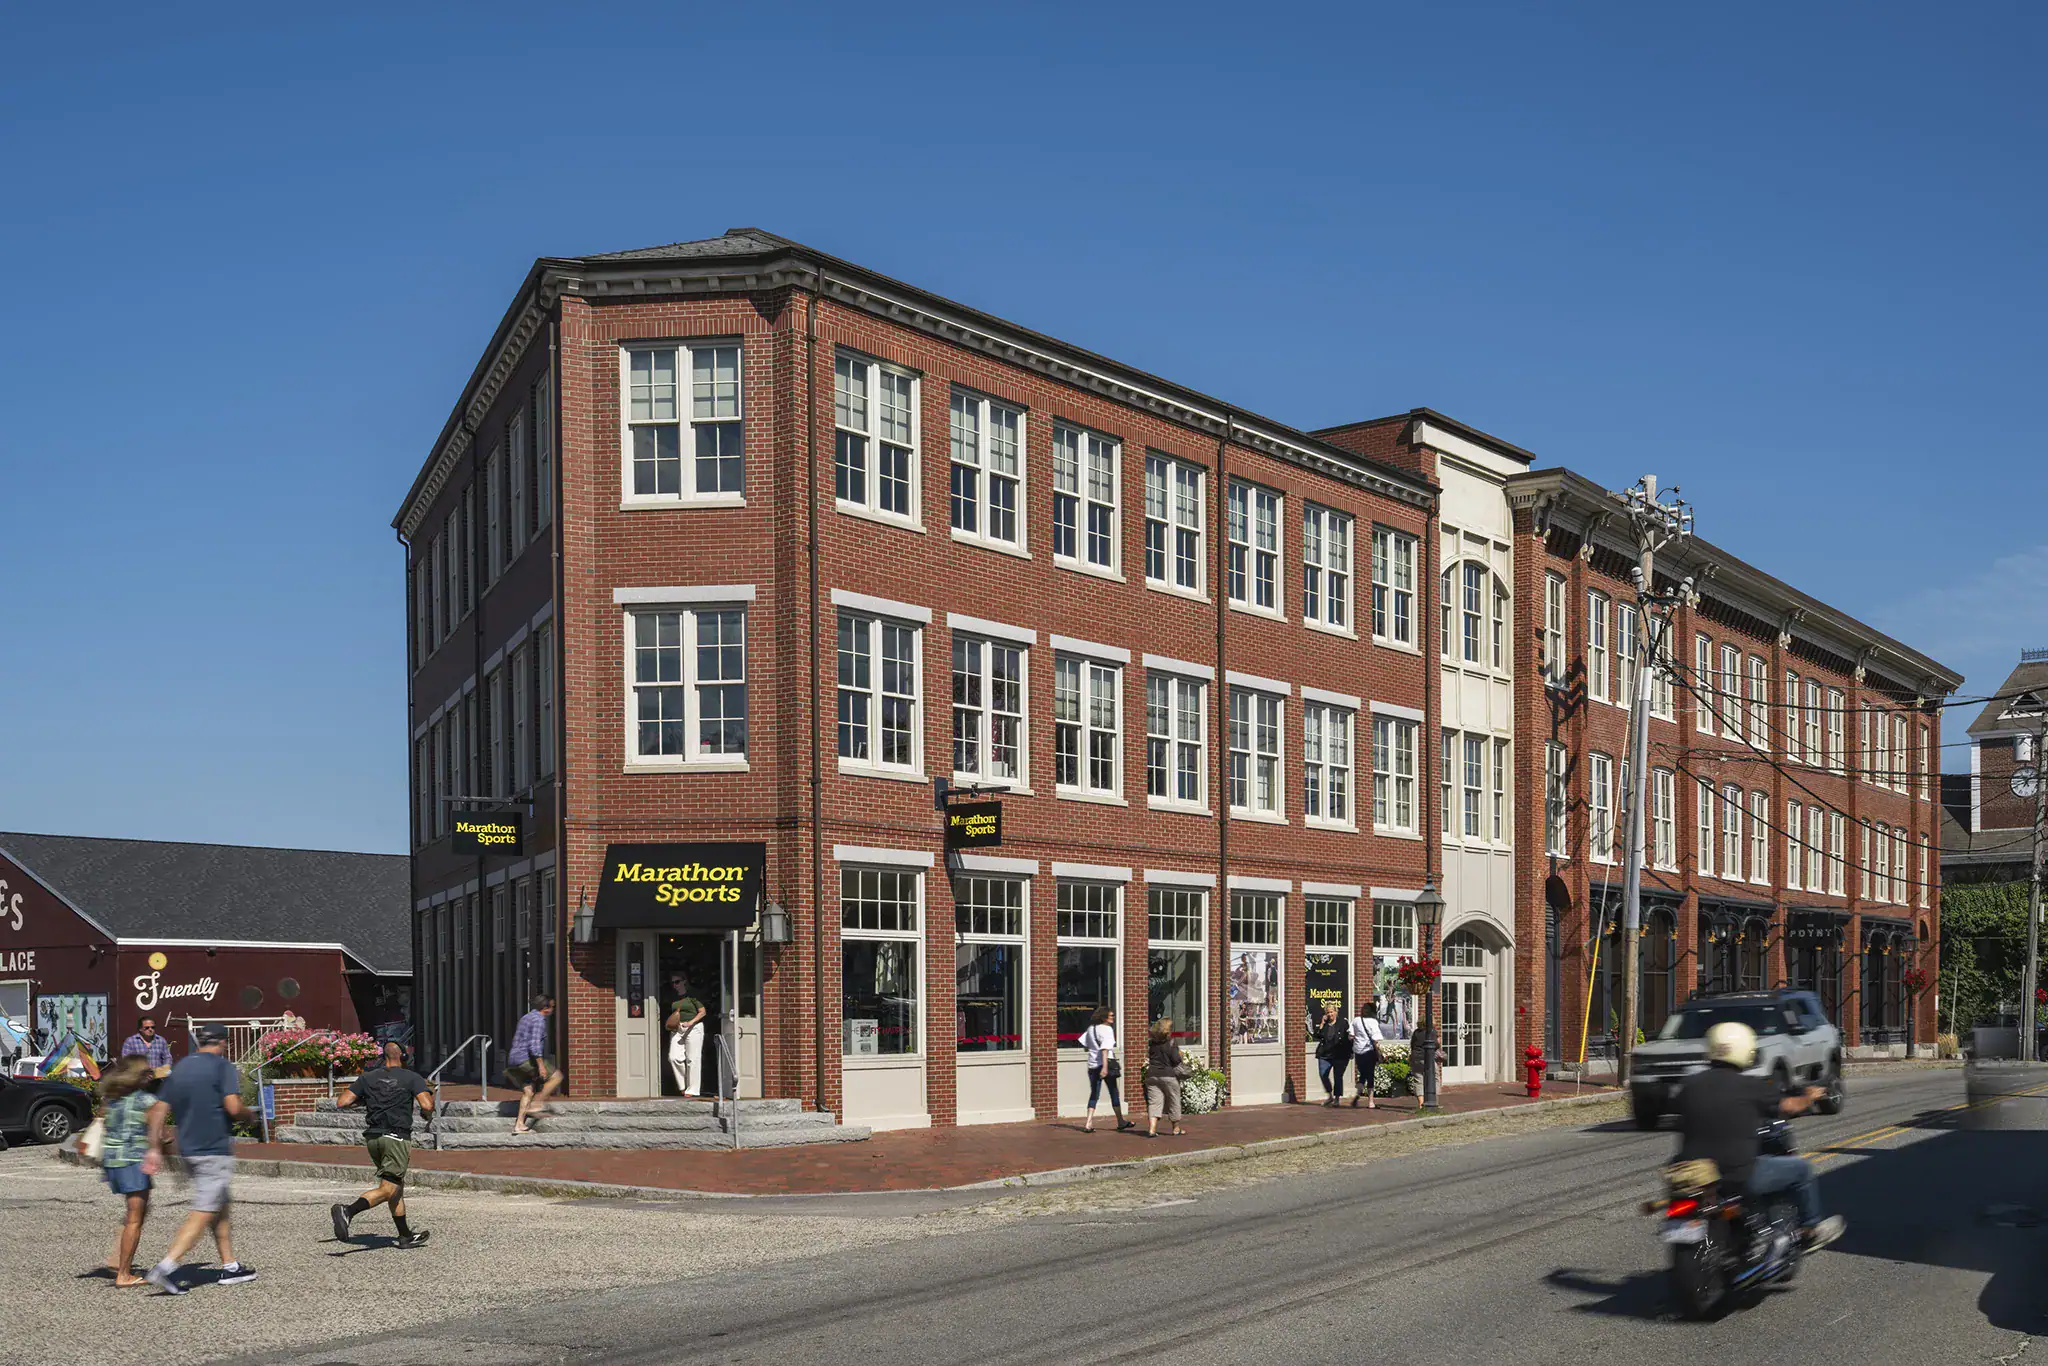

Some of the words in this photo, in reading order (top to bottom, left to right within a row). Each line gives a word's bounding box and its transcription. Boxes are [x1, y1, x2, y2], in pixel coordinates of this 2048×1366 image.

[950, 814, 996, 826] Marathon
[456, 821, 517, 833] Marathon
[965, 825, 996, 837] Sports
[477, 832, 517, 846] Sports
[614, 863, 745, 882] Marathon
[655, 883, 741, 907] Sports
[133, 970, 219, 1011] Friendly
[1309, 988, 1342, 999] Marathon
